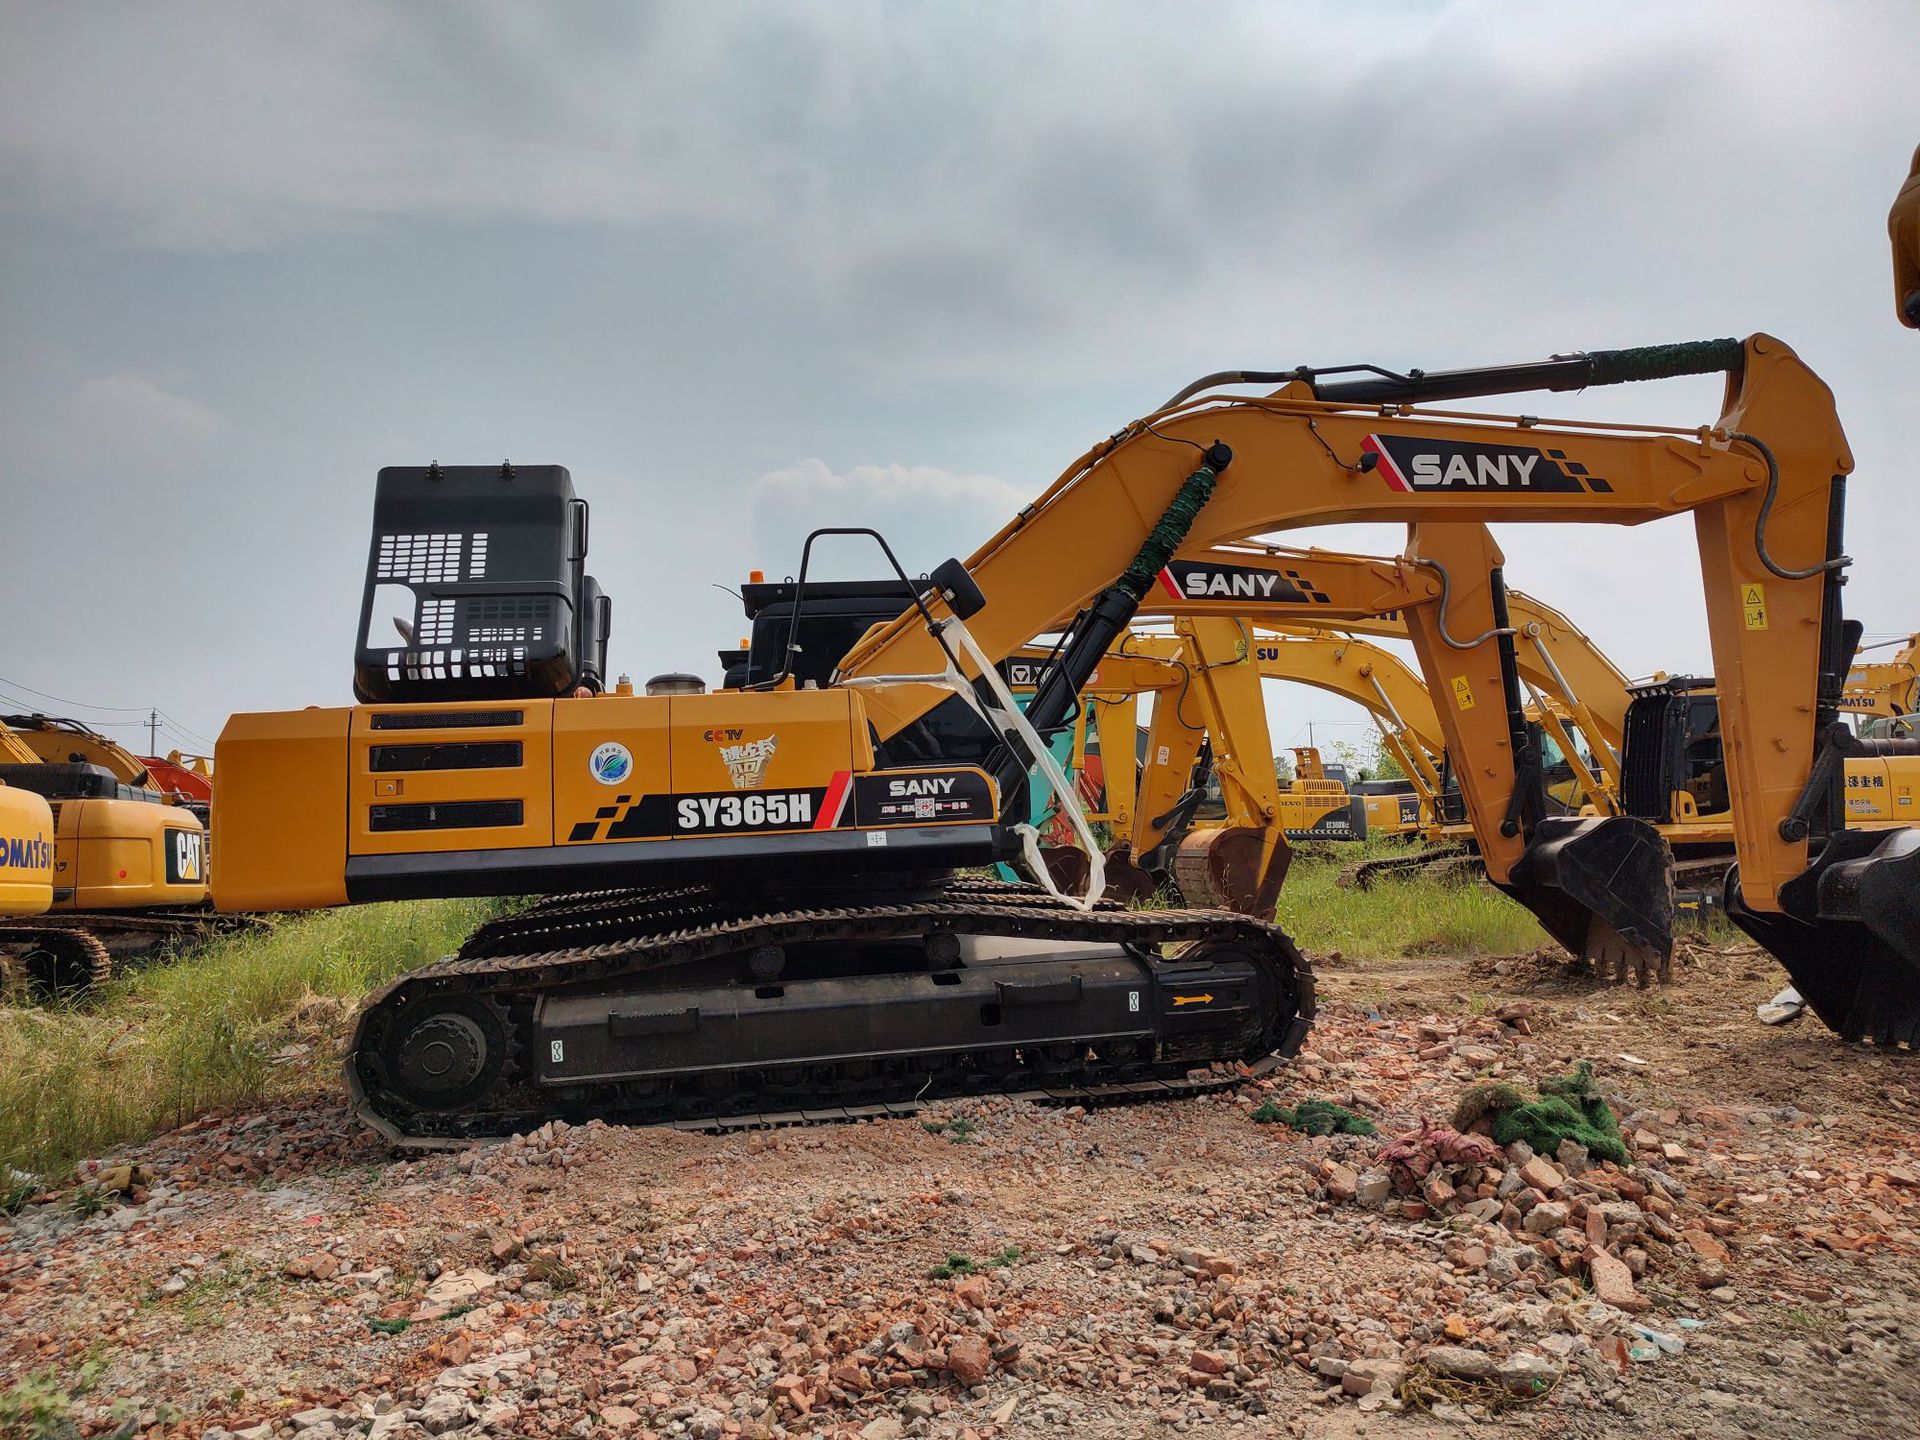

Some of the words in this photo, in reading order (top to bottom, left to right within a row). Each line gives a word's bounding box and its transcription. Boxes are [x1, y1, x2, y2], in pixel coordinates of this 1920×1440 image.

[1411, 454, 1539, 486] SANY
[1185, 572, 1278, 597] SANY
[703, 728, 744, 742] CCTV
[889, 777, 956, 797] SANY
[677, 793, 812, 829] SY365H
[176, 832, 201, 881] CAT
